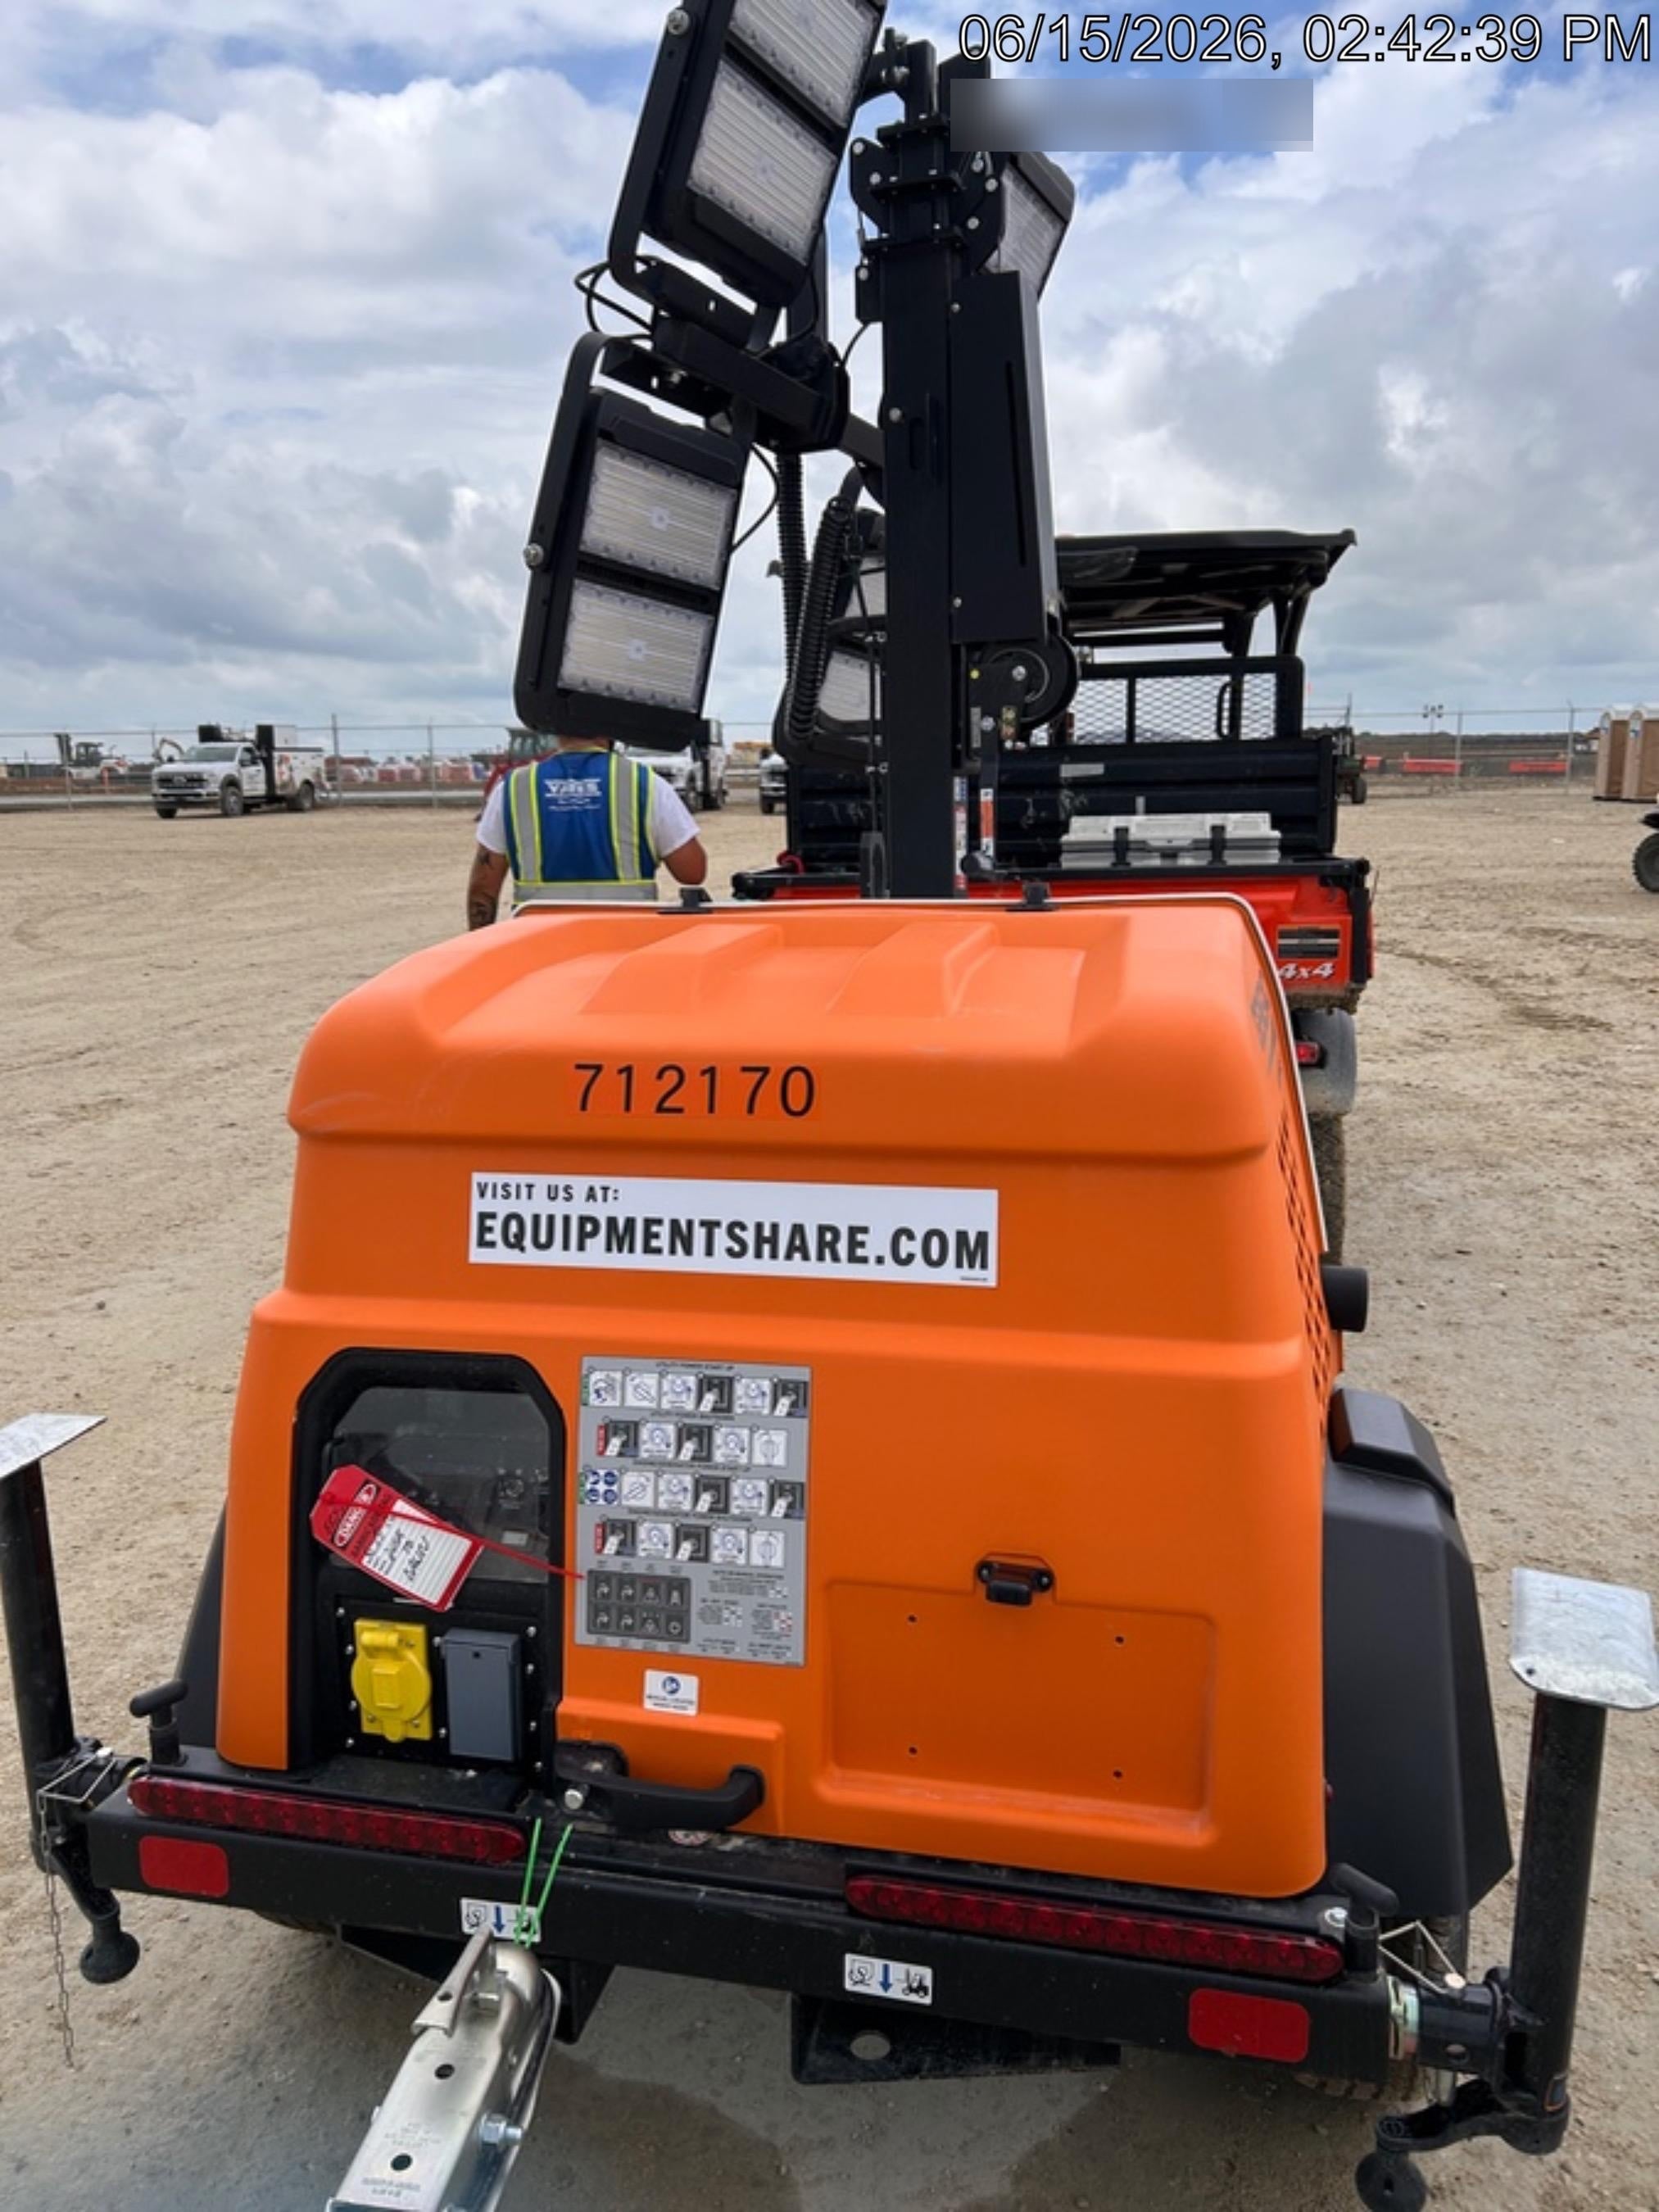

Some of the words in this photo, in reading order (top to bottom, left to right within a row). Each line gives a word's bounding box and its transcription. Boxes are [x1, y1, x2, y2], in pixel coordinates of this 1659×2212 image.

[1278, 963, 1335, 980] 4x4
[574, 1063, 815, 1117] 712170
[477, 1181, 535, 1200] VISIT
[546, 1184, 573, 1203] US
[585, 1185, 619, 1203] AT:
[476, 1212, 988, 1271] EQUIPMENTSHARE.COM
